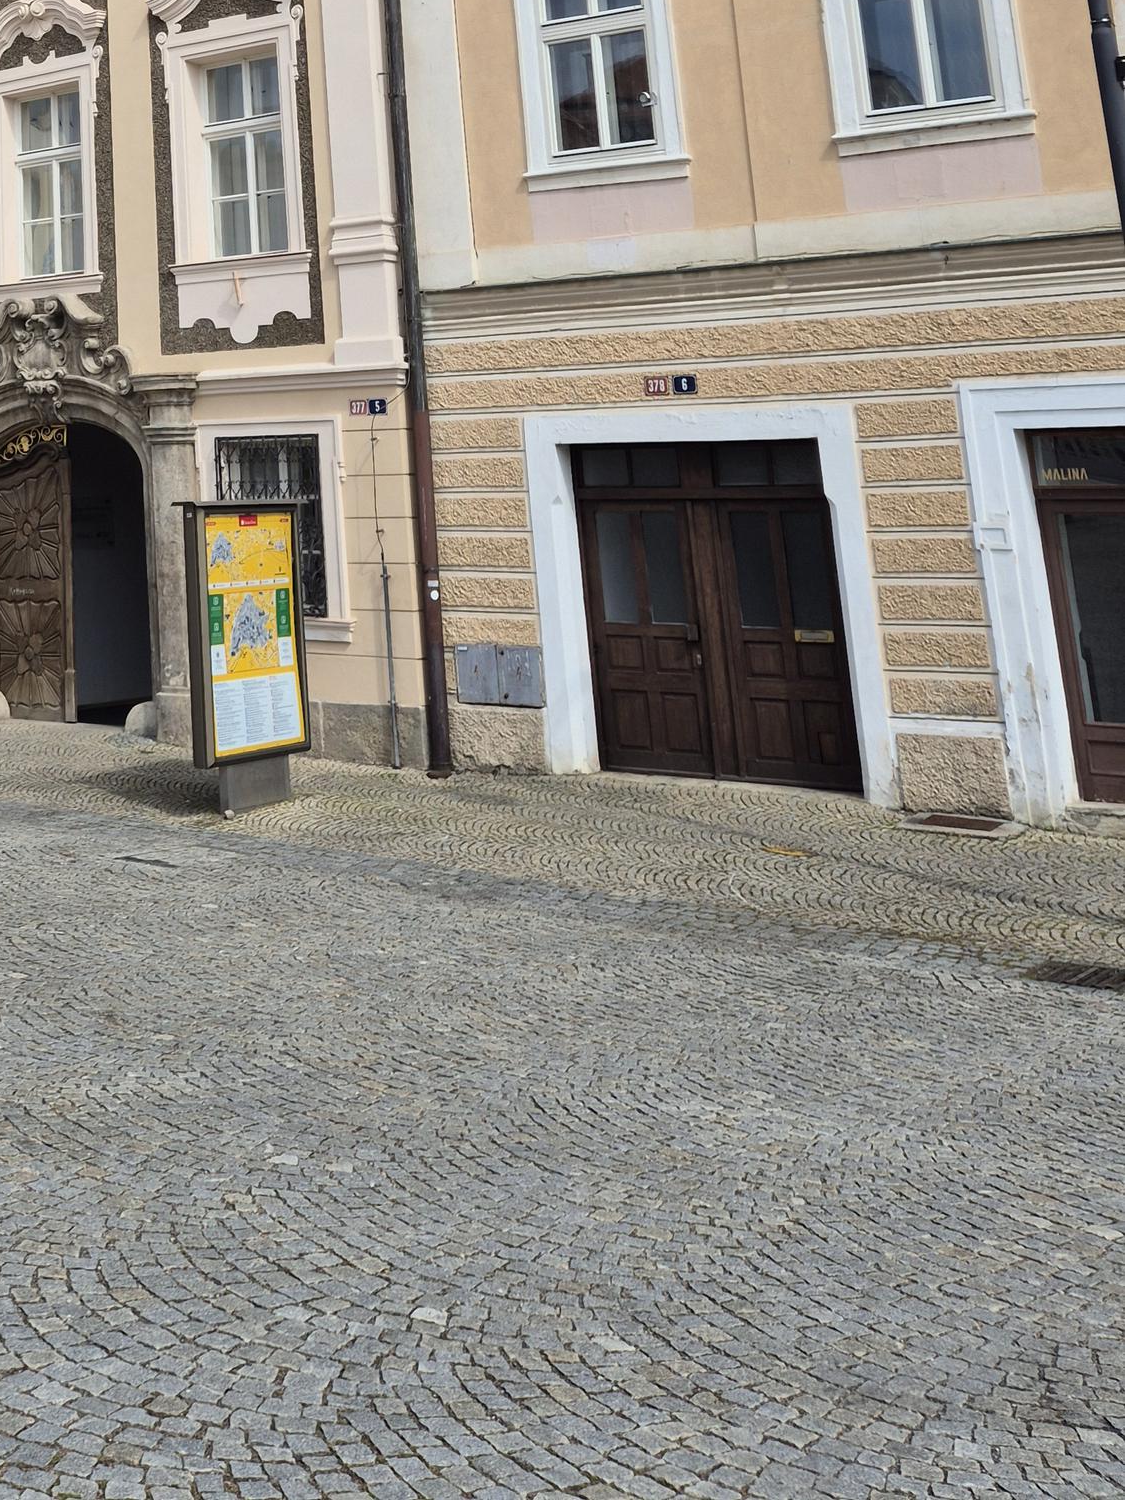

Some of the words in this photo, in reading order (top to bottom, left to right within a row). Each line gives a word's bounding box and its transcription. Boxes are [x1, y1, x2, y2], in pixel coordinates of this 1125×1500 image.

[648, 380, 665, 392] 378
[681, 378, 687, 390] 6
[351, 401, 365, 413] 377
[375, 400, 380, 412] 5
[1042, 468, 1088, 481] MALINA
